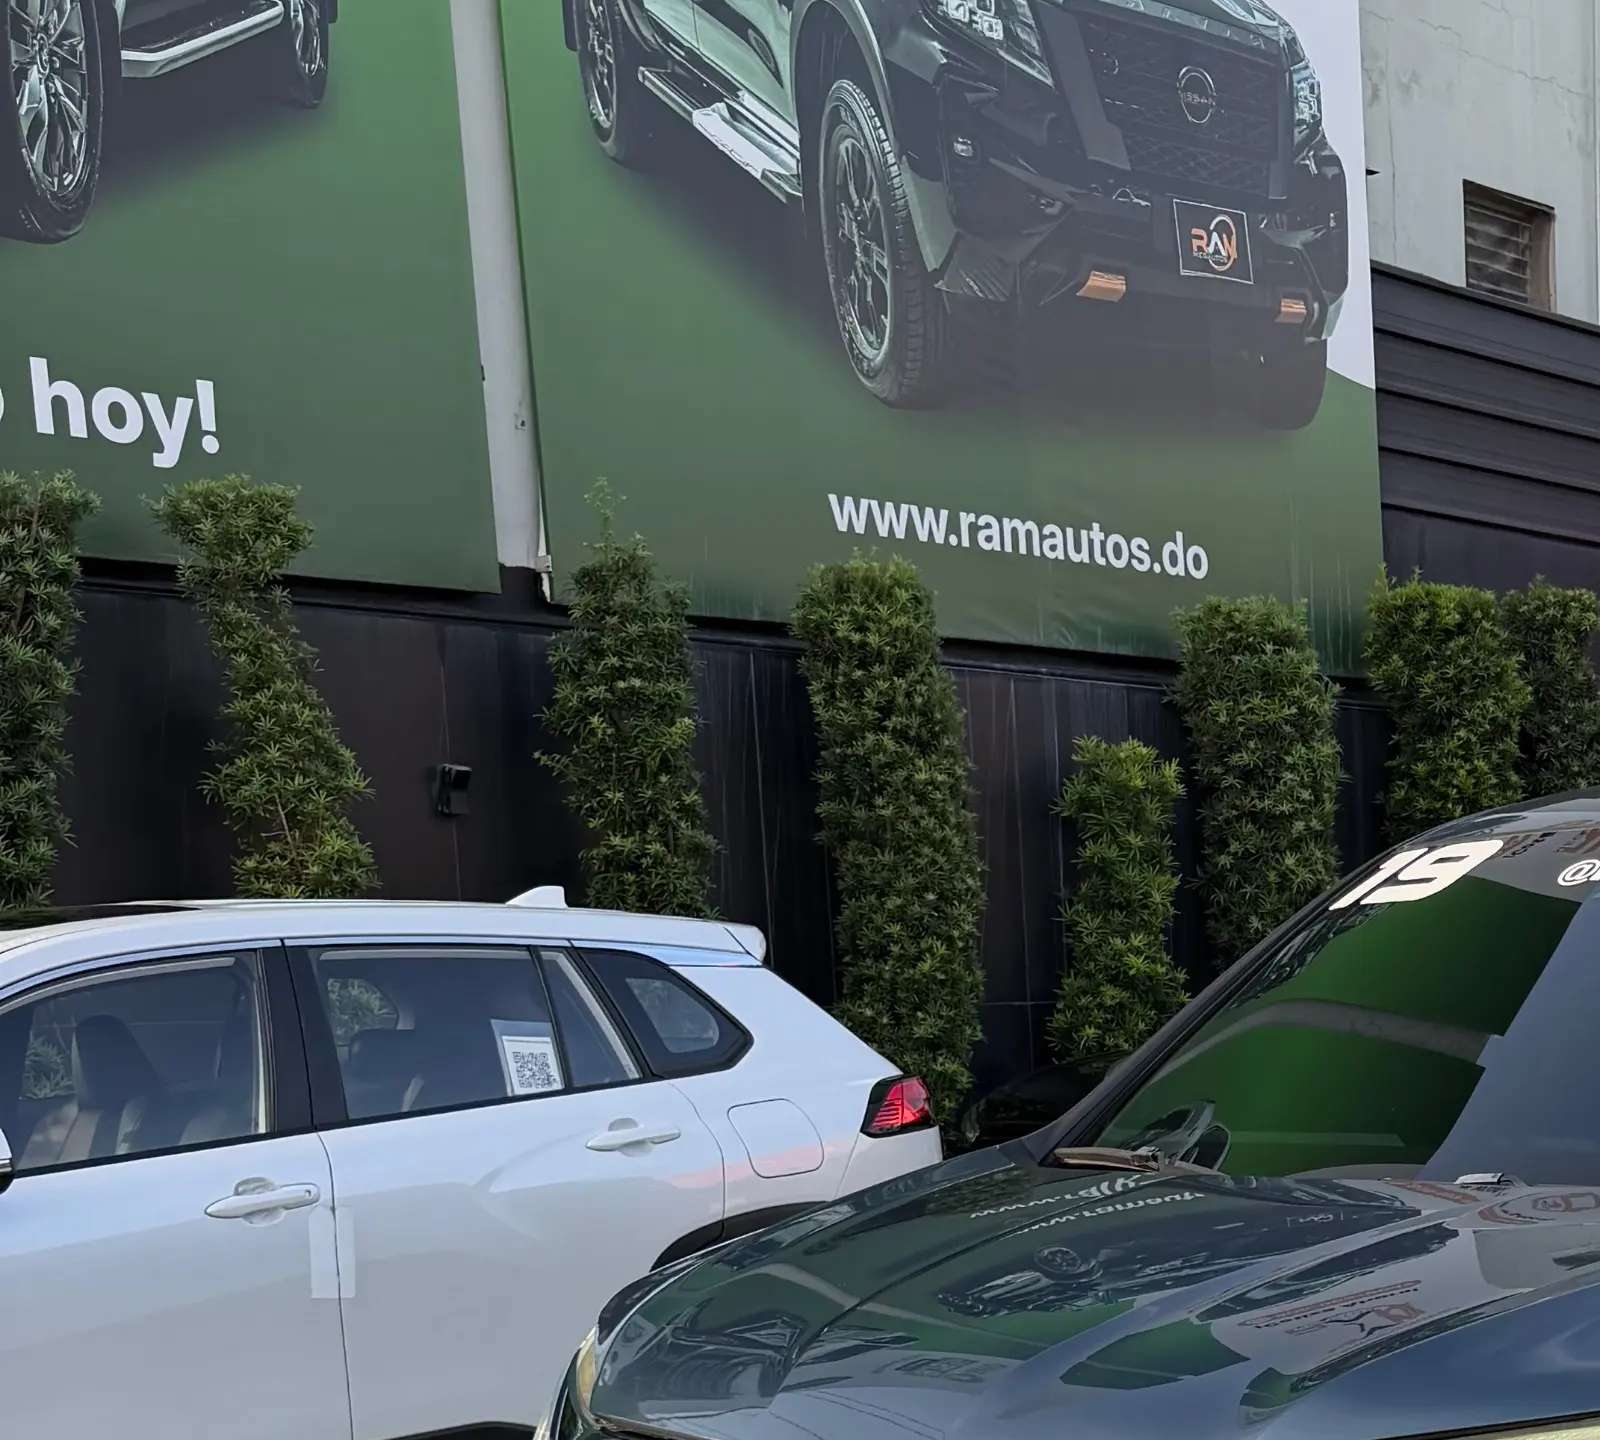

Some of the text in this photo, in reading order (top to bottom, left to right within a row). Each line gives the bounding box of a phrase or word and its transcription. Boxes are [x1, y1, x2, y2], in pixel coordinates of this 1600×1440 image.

[29, 356, 221, 468] hoy!
[828, 493, 1209, 580] www.ramautos.do
[1329, 839, 1504, 910] 19
